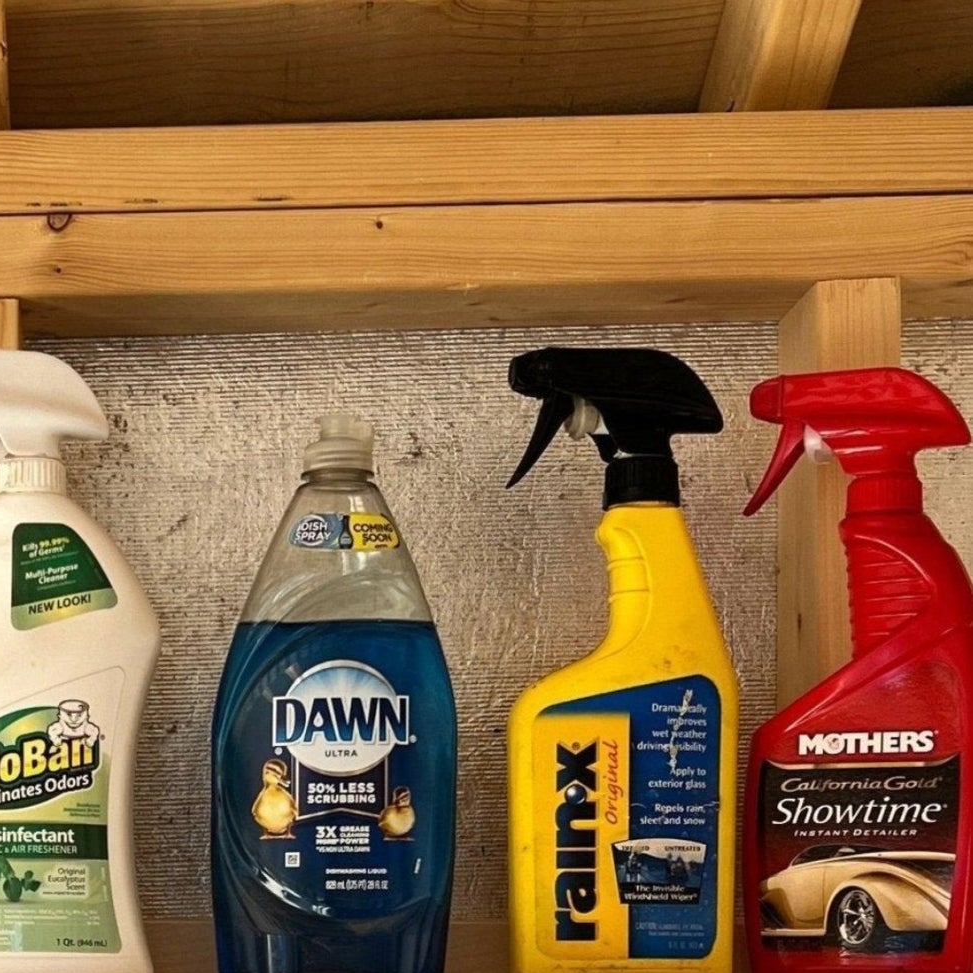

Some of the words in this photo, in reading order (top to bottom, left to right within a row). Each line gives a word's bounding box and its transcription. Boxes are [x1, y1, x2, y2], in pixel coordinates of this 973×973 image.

[301, 521, 328, 532] DISH
[353, 523, 393, 533] COMING
[294, 531, 331, 541] SPRAY
[362, 533, 392, 542] SOON
[22, 542, 38, 552] Kills
[29, 549, 37, 558] of
[25, 564, 79, 580] Multi-Purpose
[38, 573, 68, 584] Cleaner
[28, 600, 54, 615] NEW
[57, 594, 91, 609] LOOK!
[272, 696, 410, 746] DAWN
[652, 730, 669, 739] wet
[799, 731, 934, 755] MOTHERS
[695, 767, 706, 776] to
[44, 773, 89, 792] Odors
[602, 740, 625, 826] Original
[648, 779, 684, 789] exterior
[685, 779, 706, 790] glass
[780, 777, 883, 793] California
[883, 776, 938, 791] Gold
[307, 783, 335, 794] 50%
[339, 783, 375, 794] LESS
[307, 795, 376, 805] SCRUBBING
[655, 804, 684, 815] Repels
[772, 796, 942, 825] Showtime
[640, 816, 662, 825] sleet
[663, 816, 681, 825] and
[683, 817, 706, 825] snow
[316, 826, 336, 838] 3X
[853, 829, 917, 837] DETAILER
[10, 845, 26, 853] AIR
[28, 845, 77, 854] FRESHENER
[58, 868, 85, 877] Original
[48, 875, 85, 884] Eucalyptus
[66, 882, 85, 891] Scent
[62, 938, 75, 947] Qt.
